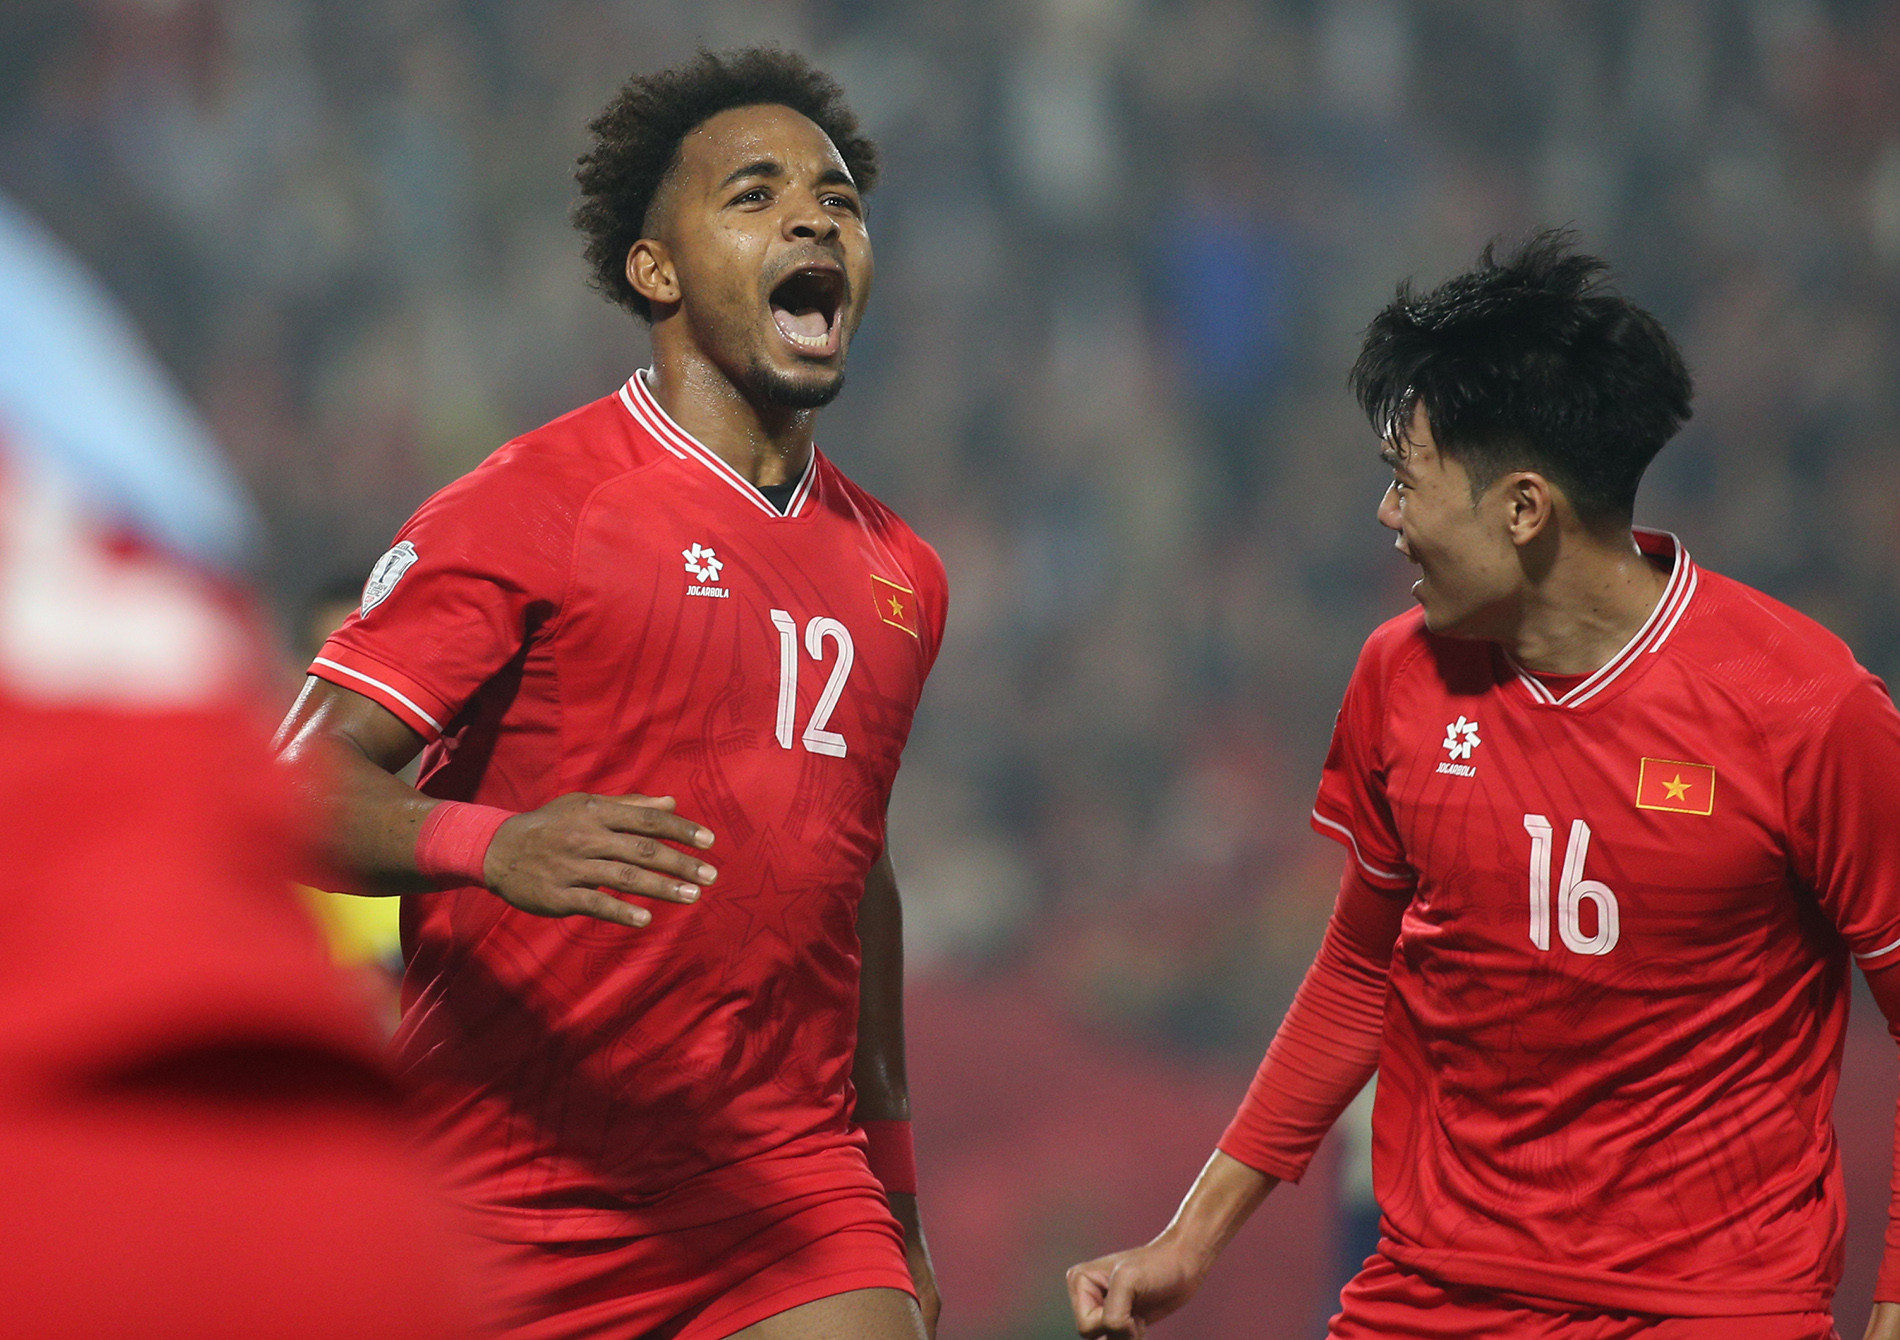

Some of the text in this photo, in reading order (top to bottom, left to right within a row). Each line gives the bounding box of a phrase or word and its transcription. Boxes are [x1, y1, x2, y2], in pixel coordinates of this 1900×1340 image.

[686, 585, 729, 598] JOGARBOLA
[769, 608, 855, 759] 12
[1435, 761, 1477, 778] JOGARBOLA
[1523, 813, 1620, 956] 16
